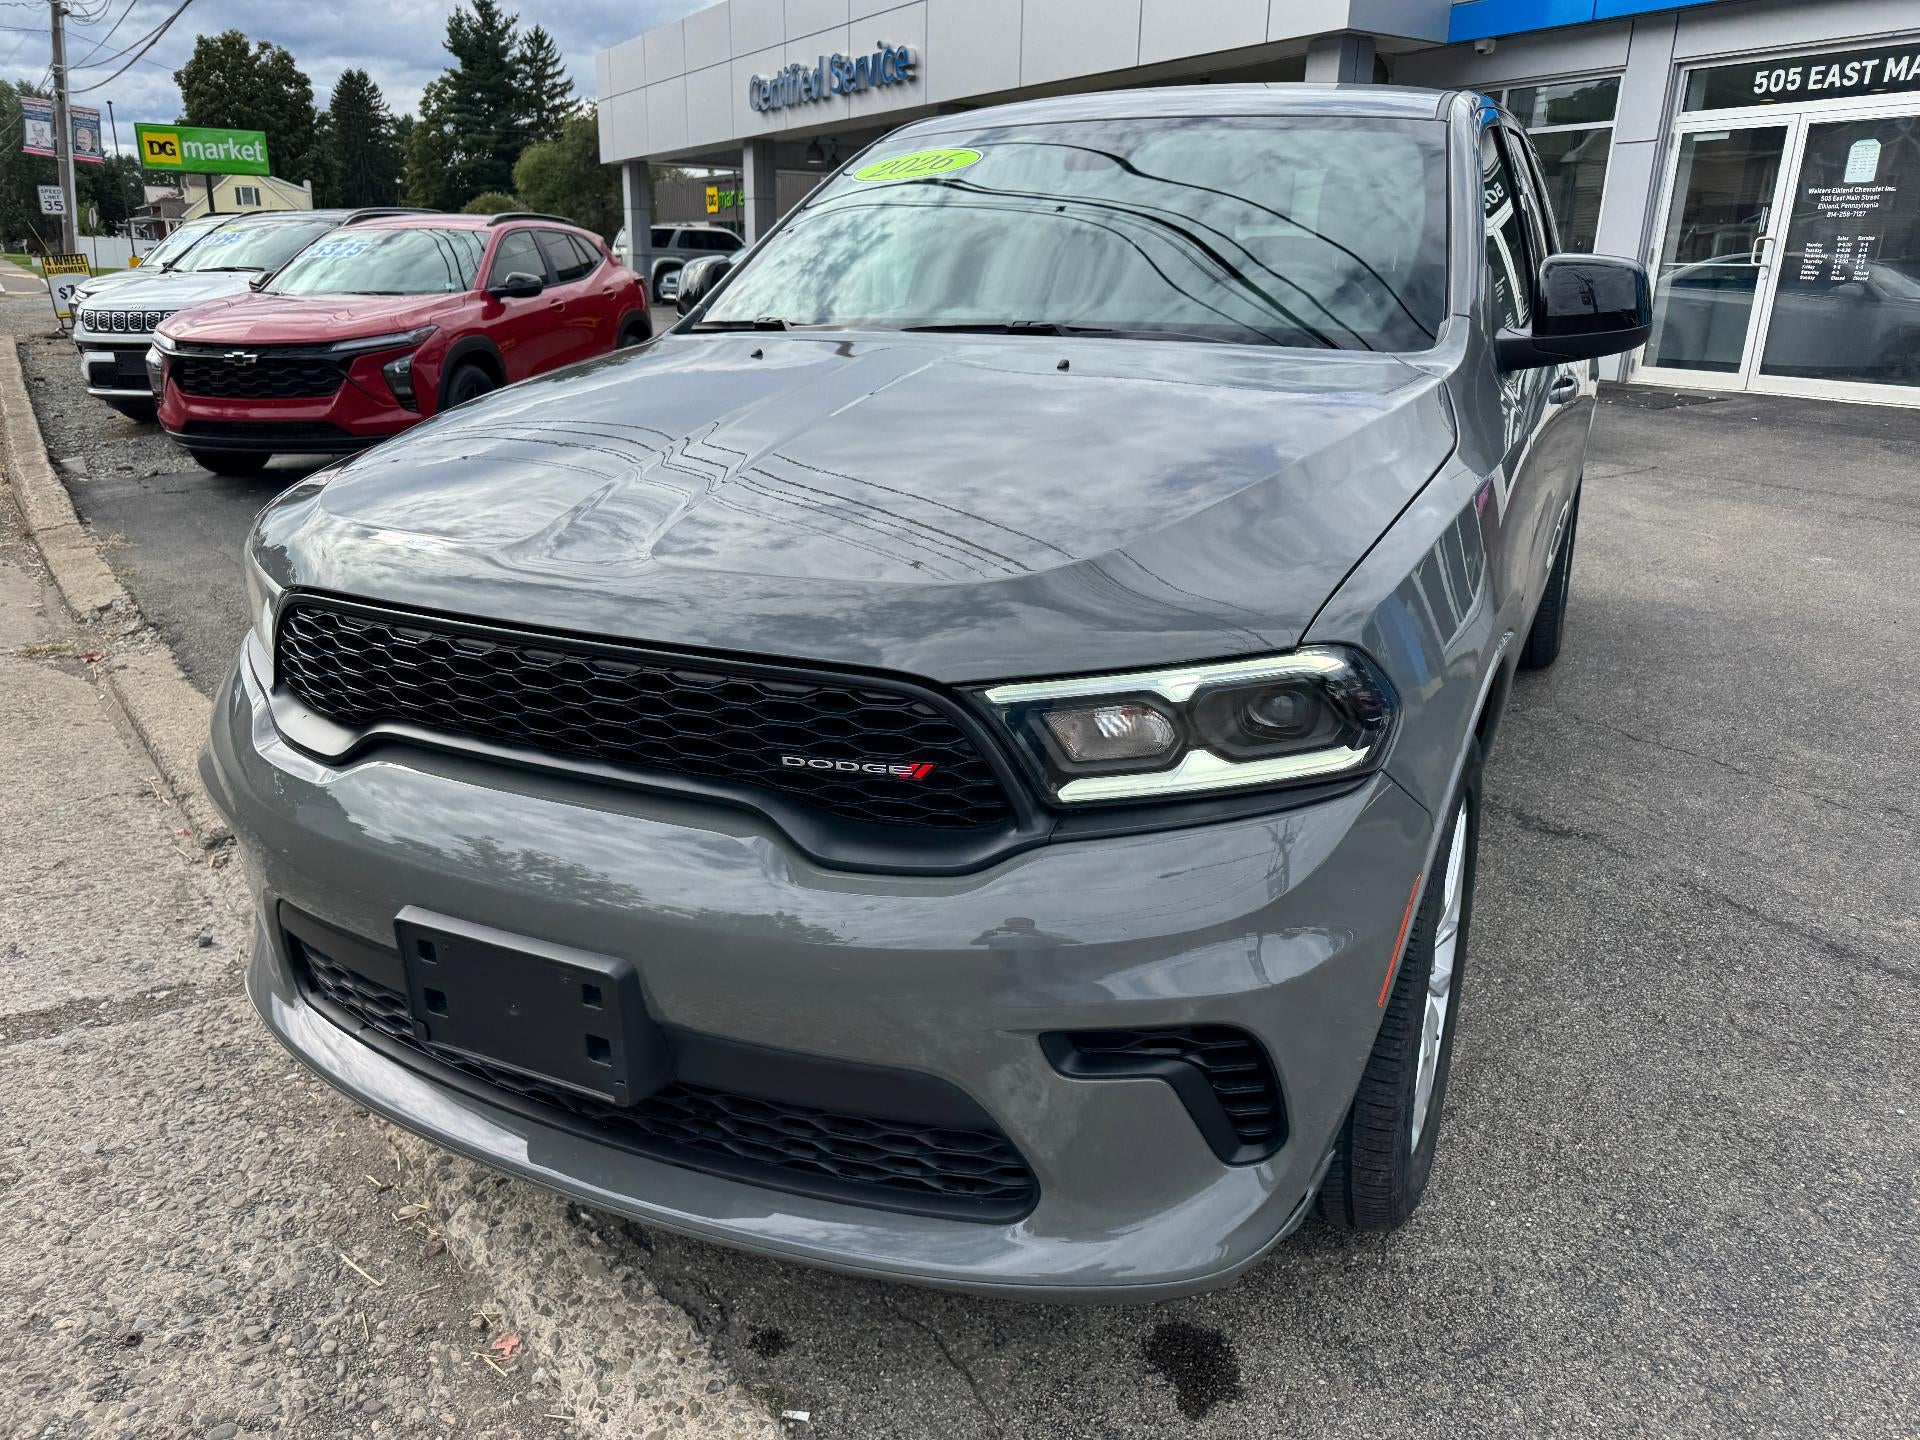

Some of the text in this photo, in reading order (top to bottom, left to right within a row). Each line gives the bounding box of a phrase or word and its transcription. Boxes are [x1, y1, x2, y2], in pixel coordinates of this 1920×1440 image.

[750, 40, 917, 111] Certified Service
[1753, 54, 1920, 94] 505 EAST MA
[147, 138, 265, 161] DG market
[865, 153, 967, 179] 2026
[44, 200, 64, 212] 35
[45, 254, 87, 266] 4 WHEEL
[47, 265, 87, 274] ALIGNMENT
[781, 755, 914, 777] DODGE
